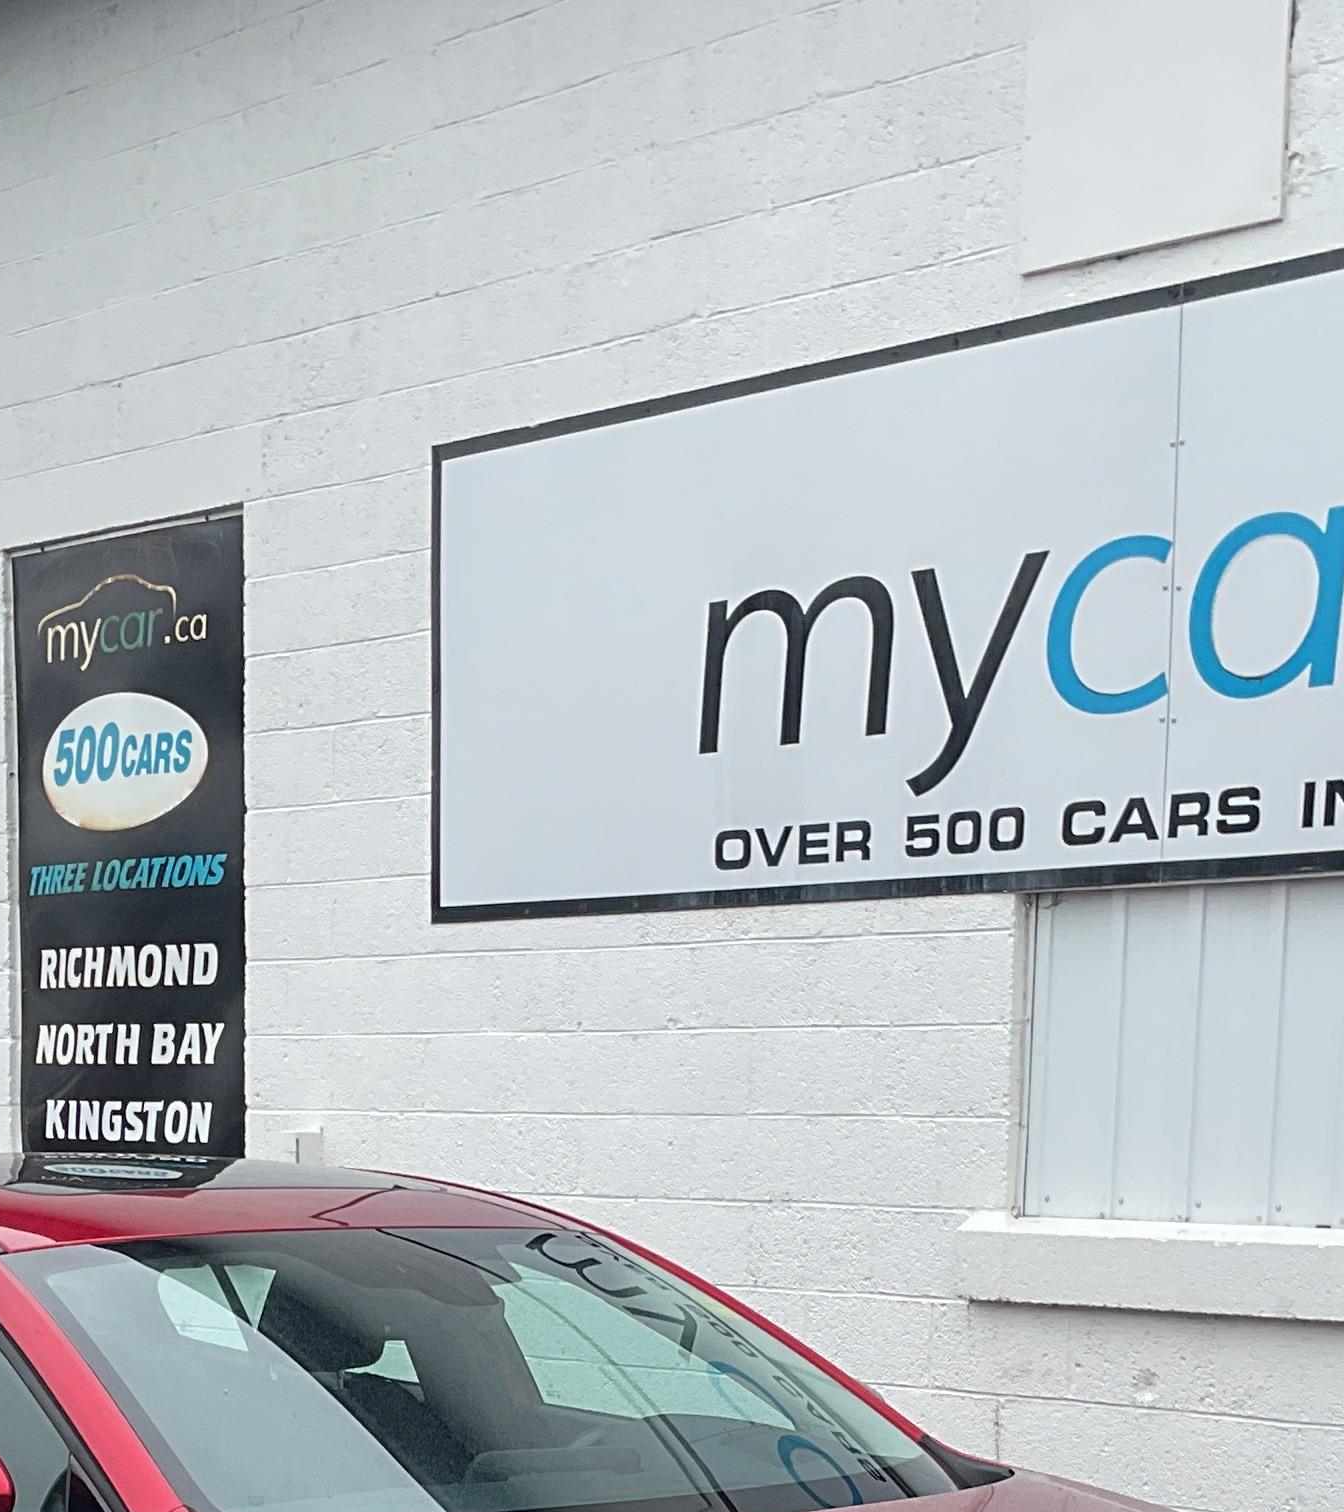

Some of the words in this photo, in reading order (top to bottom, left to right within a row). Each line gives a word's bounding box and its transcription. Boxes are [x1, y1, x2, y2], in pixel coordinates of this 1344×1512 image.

[713, 820, 872, 871] OVER
[904, 806, 1025, 857] 500
[1061, 786, 1261, 846] CARS
[29, 861, 88, 897] THREE
[90, 853, 228, 892] LOCATIONS
[39, 942, 219, 990] RICHMOND
[35, 1022, 141, 1066] NORTH
[150, 1022, 225, 1065] BAY
[45, 1099, 213, 1144] KINGSTON
